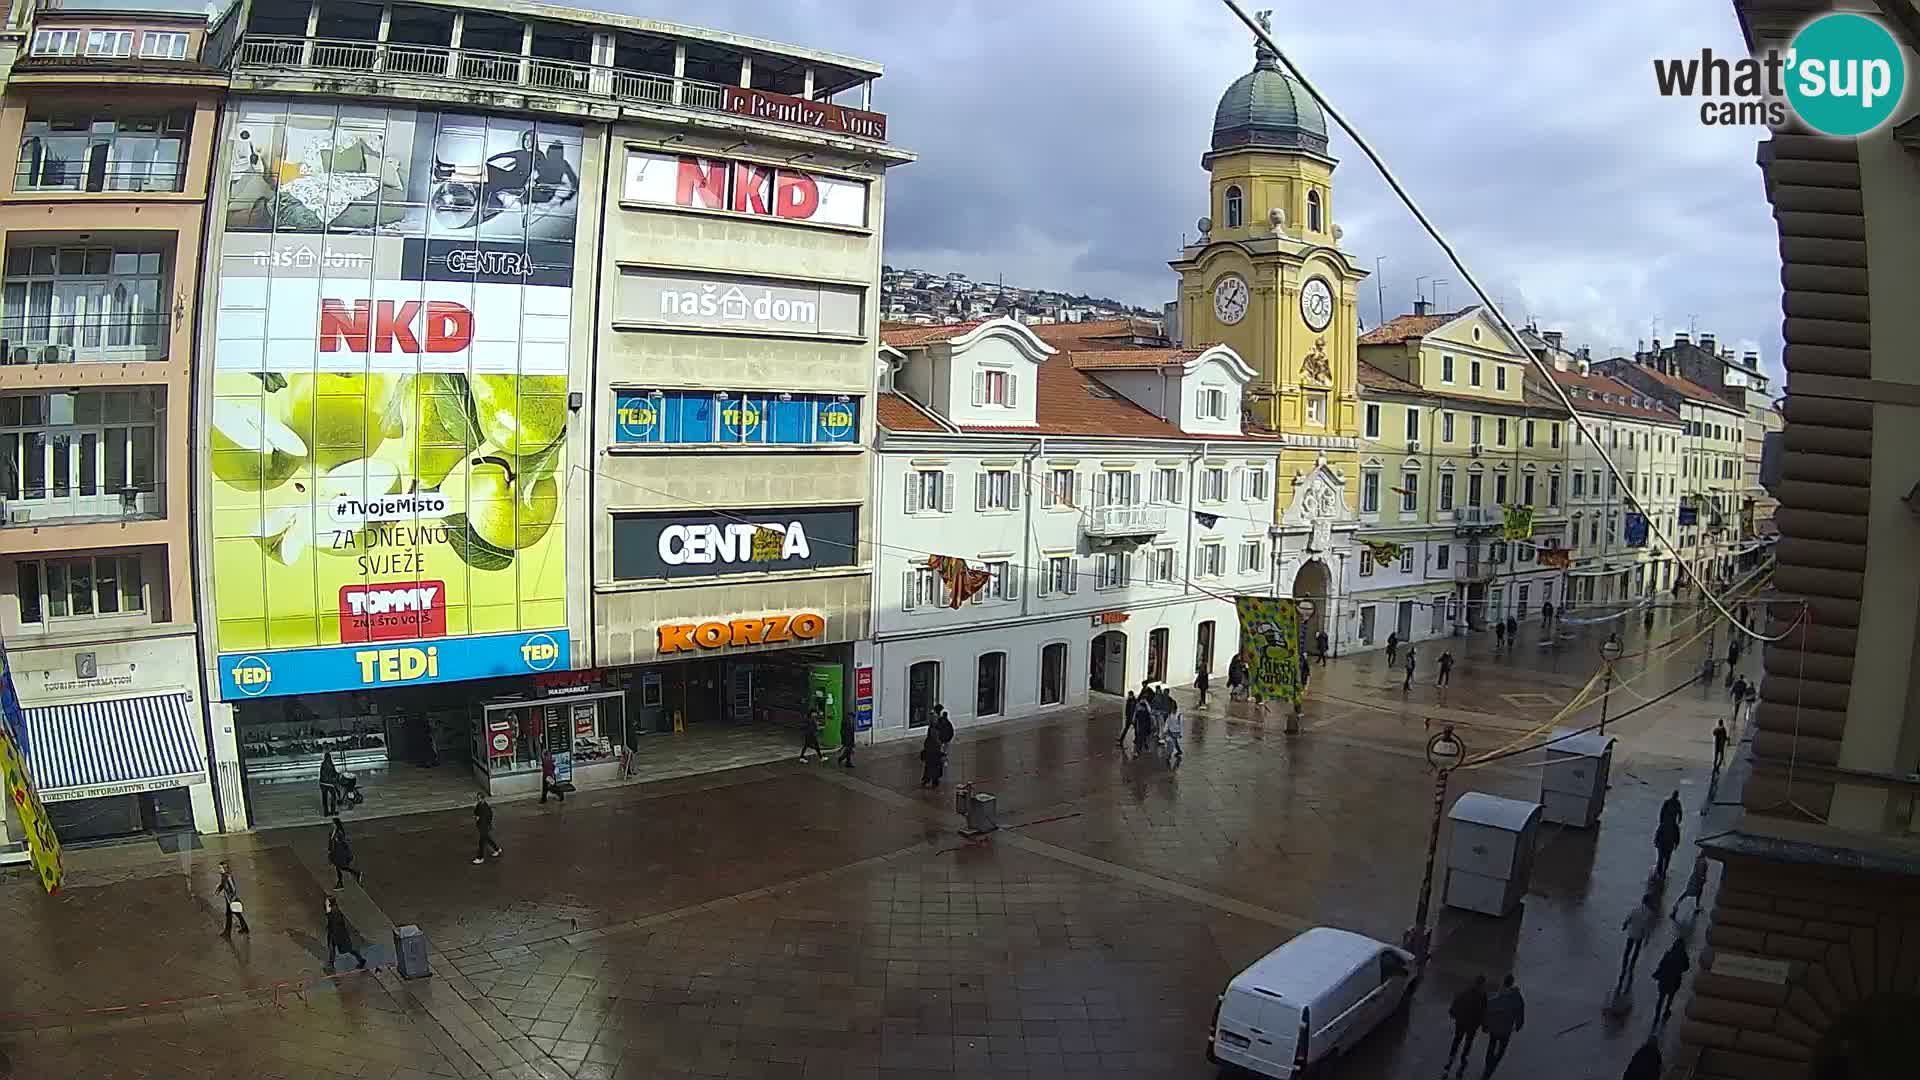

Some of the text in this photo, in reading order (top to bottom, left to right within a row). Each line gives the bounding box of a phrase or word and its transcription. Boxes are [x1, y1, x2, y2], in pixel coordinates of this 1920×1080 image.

[723, 89, 745, 112] Le
[675, 156, 819, 219] NKD
[253, 246, 364, 268] naš dom
[447, 250, 534, 275] CENTRA
[661, 284, 817, 323] naš dom
[319, 298, 475, 353] NKD
[618, 408, 657, 425] TEDi
[723, 409, 760, 426] TEDi
[337, 499, 445, 517] #TvojeMisto
[332, 526, 449, 550] ZA DNEVNO
[658, 521, 810, 565] CENTA
[358, 548, 425, 576] SVJEŽE
[347, 587, 438, 615] TOMMY
[657, 614, 825, 653] KORZO
[356, 646, 439, 683] TEDi
[521, 644, 559, 662] TEDi
[232, 665, 272, 686] TEDi
